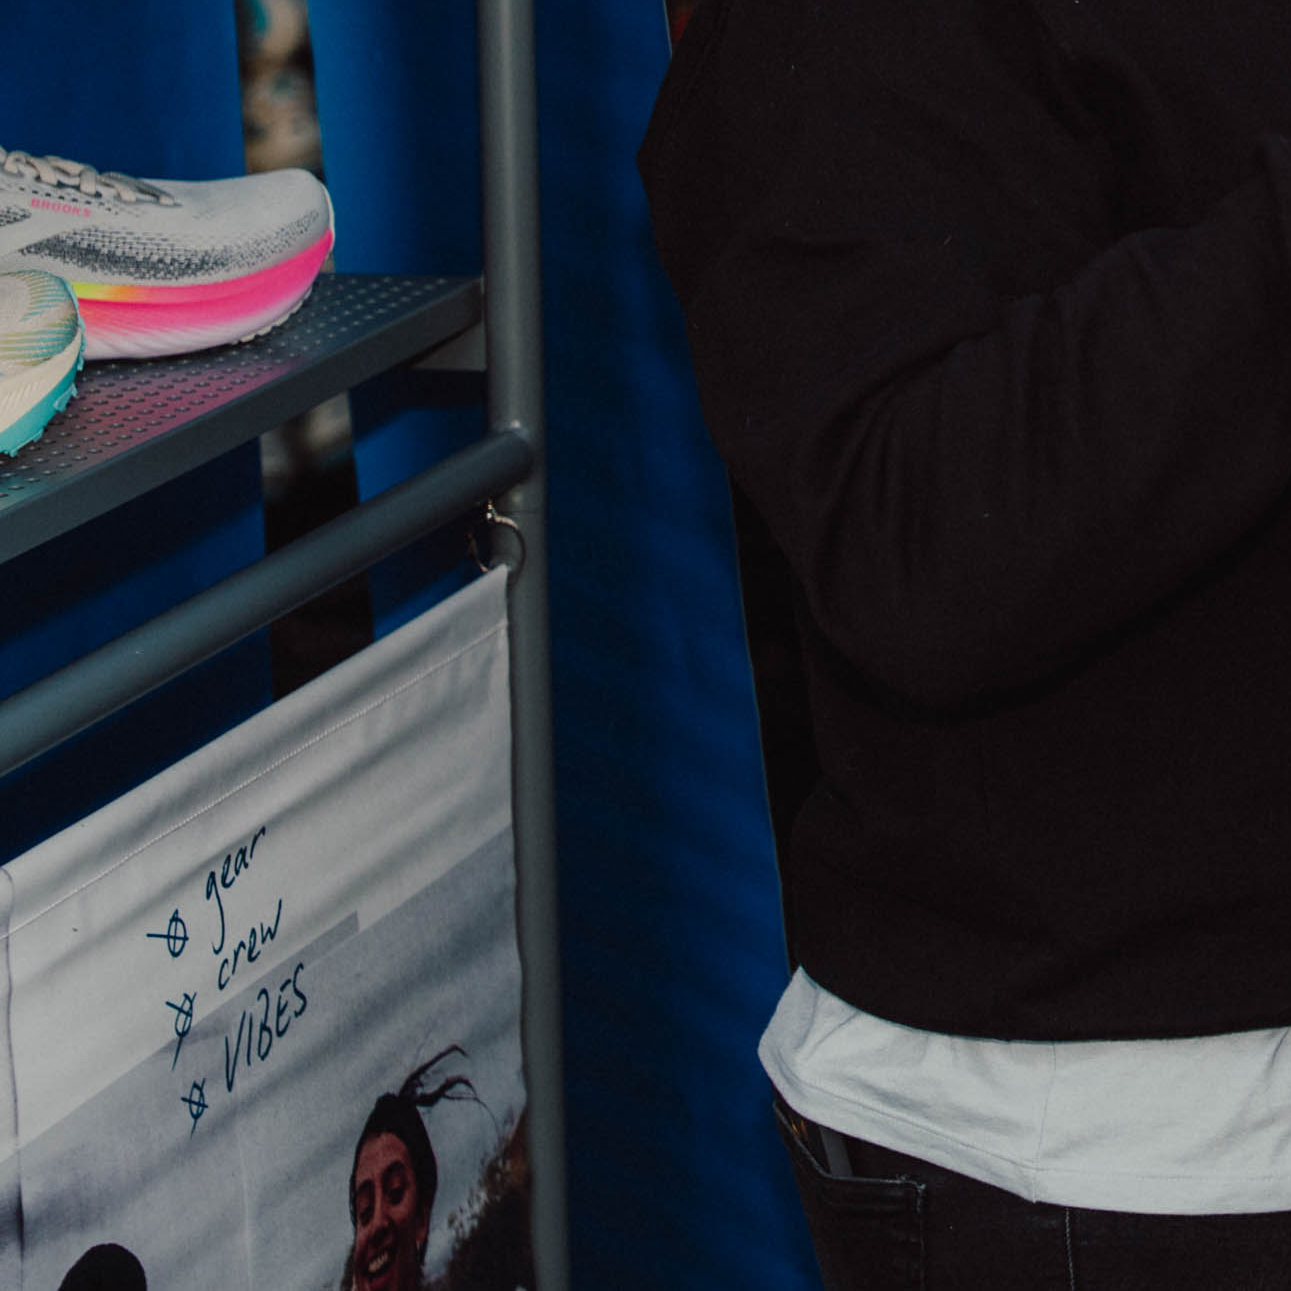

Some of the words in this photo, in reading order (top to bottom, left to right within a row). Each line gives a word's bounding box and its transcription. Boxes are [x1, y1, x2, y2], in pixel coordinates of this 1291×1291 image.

[205, 825, 267, 956] gear
[217, 898, 283, 991] crew
[224, 962, 308, 1093] VIBES
